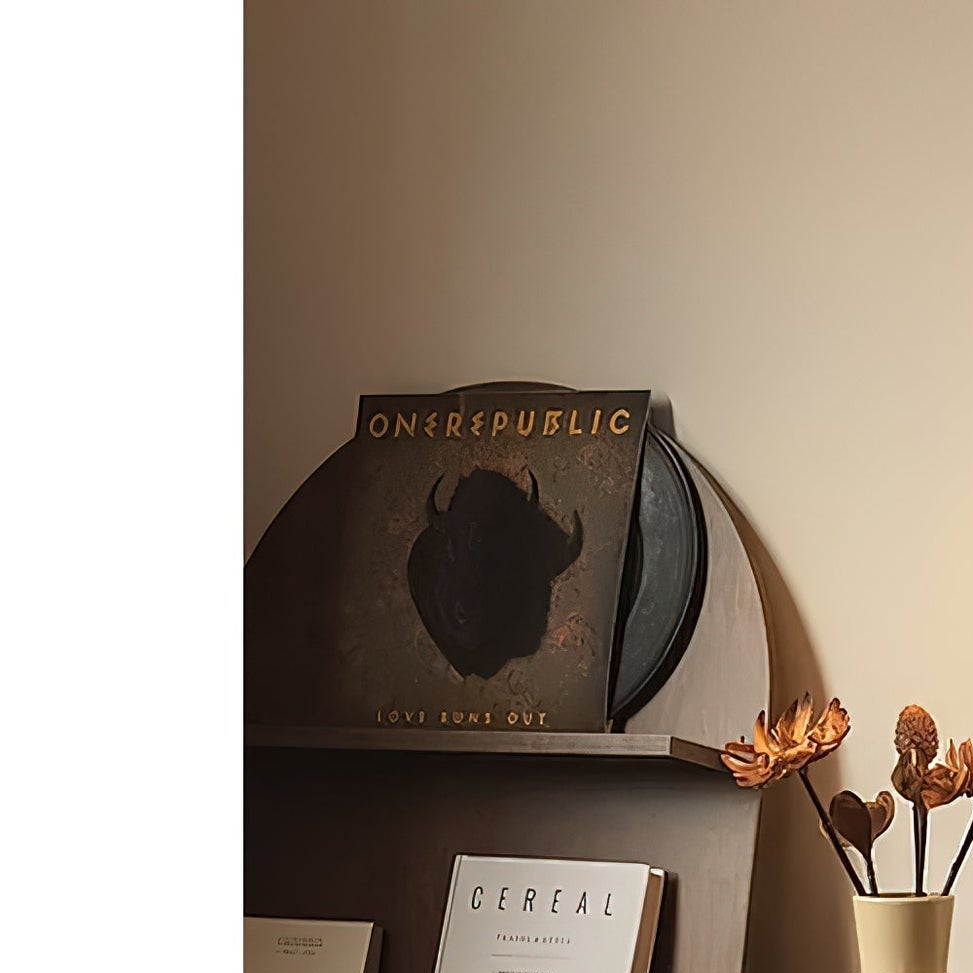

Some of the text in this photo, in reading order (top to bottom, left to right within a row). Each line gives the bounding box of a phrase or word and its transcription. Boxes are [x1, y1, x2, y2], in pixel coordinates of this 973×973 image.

[368, 408, 631, 438] ONEREPUBLIC
[507, 712, 547, 726] OUT
[471, 886, 613, 917] CEREAL
